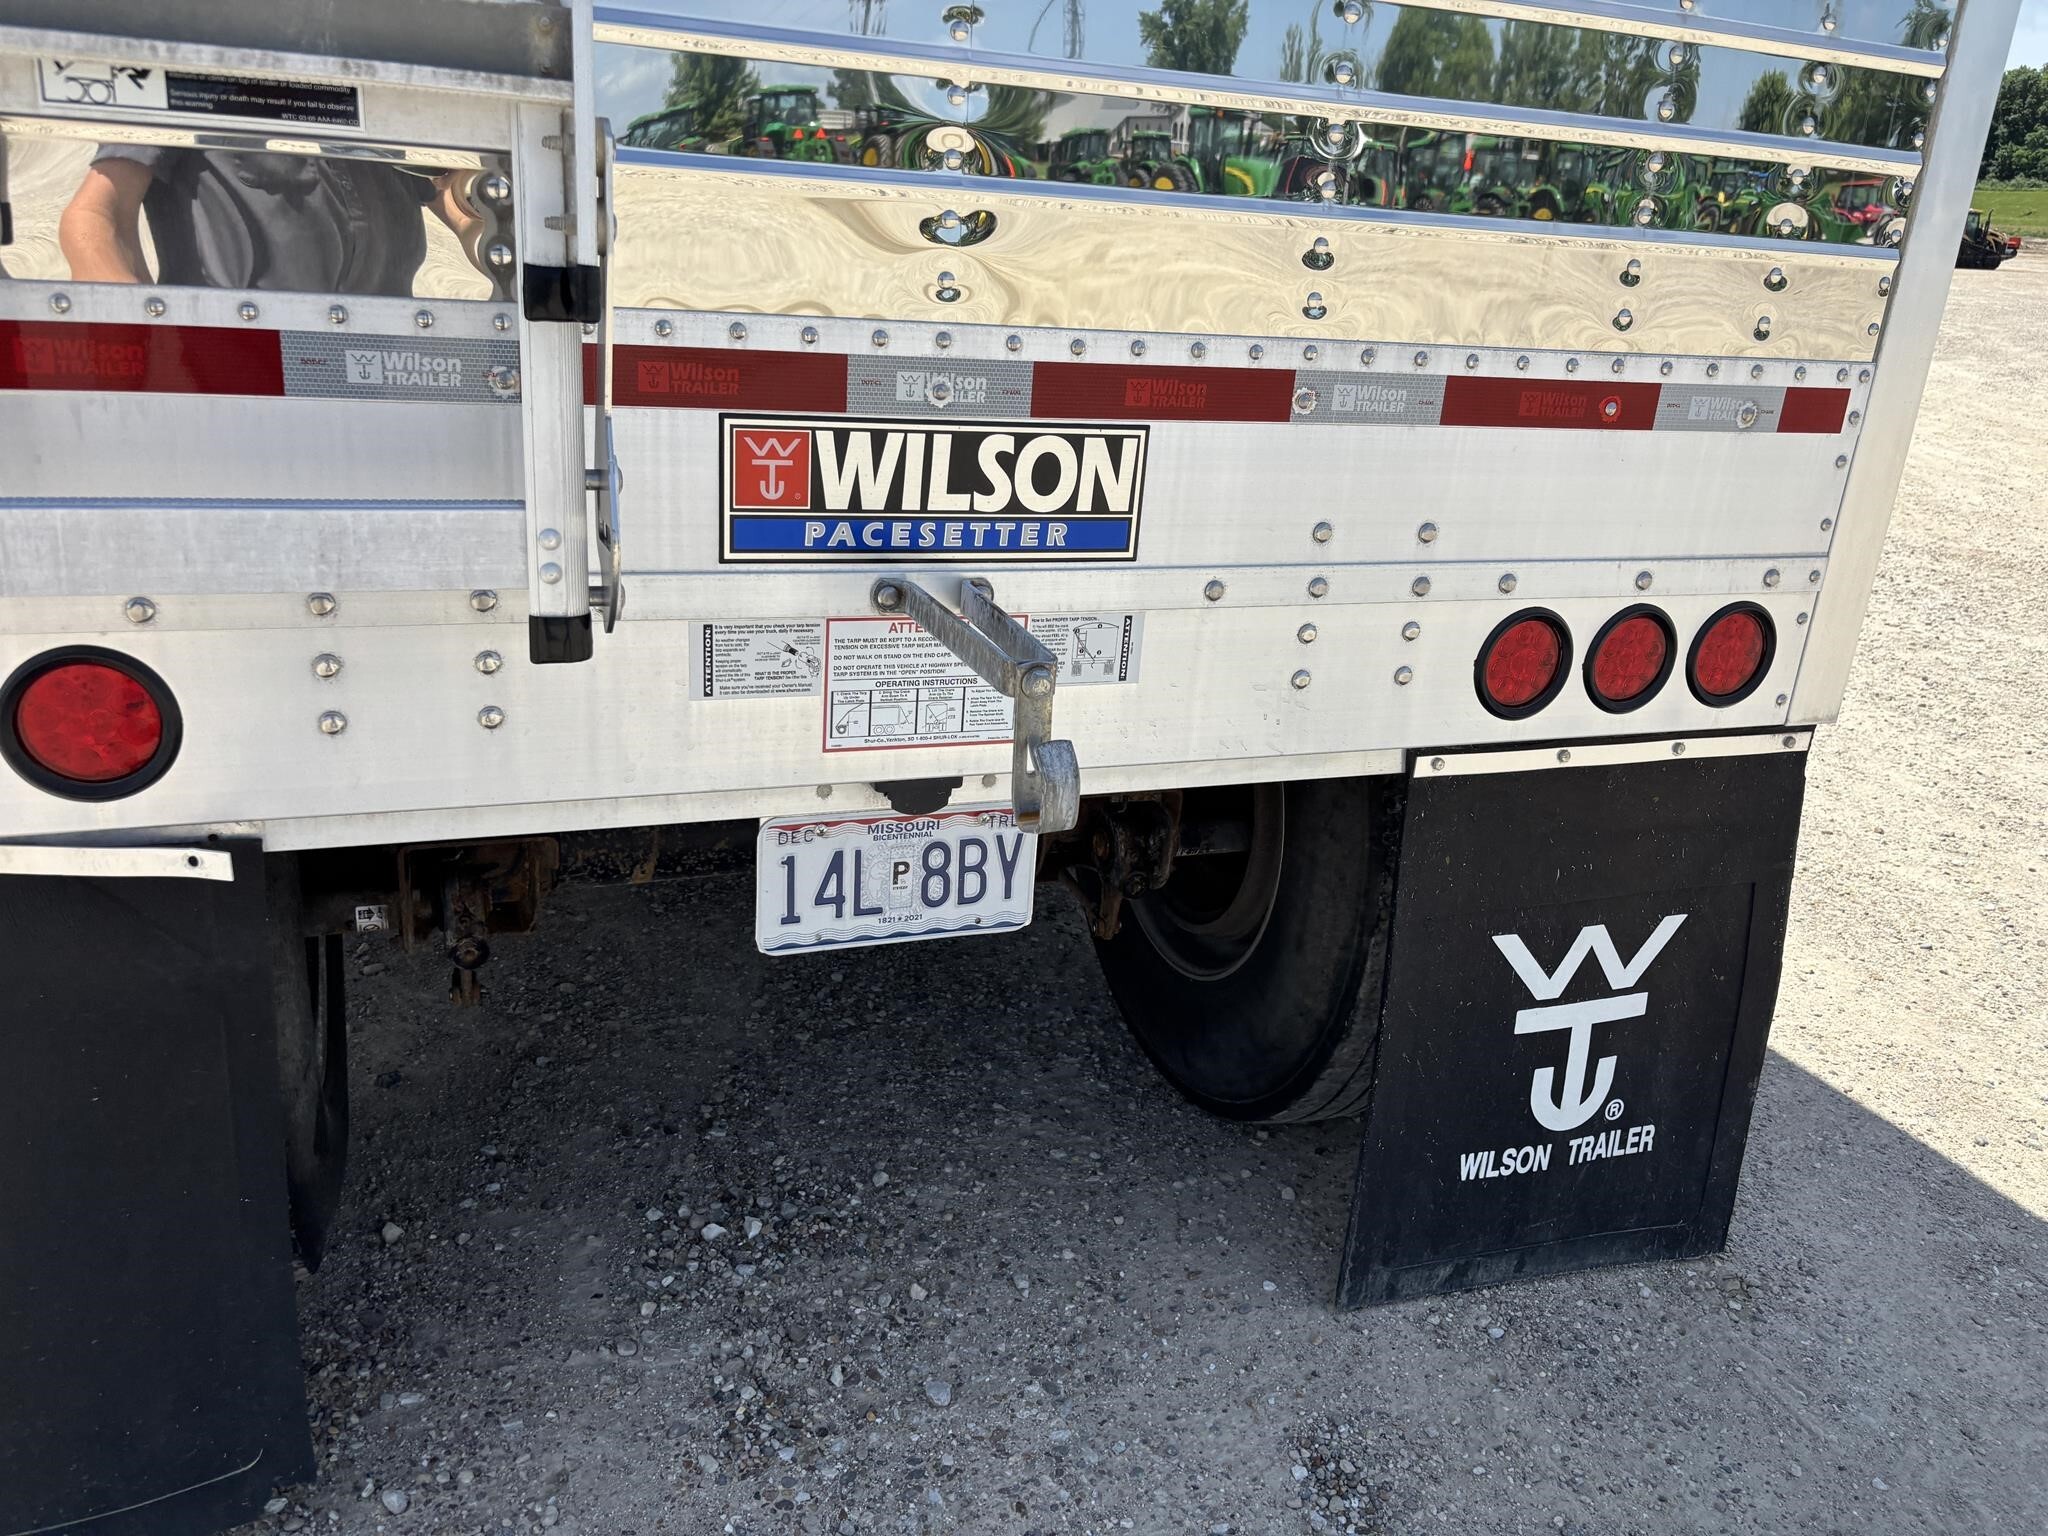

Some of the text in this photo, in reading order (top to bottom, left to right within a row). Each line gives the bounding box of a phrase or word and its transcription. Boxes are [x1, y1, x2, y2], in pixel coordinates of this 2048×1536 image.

[170, 89, 198, 98] Serious
[200, 93, 218, 101] injury
[229, 94, 249, 102] death
[289, 82, 312, 90] loaded
[314, 85, 351, 94] commodity
[54, 338, 145, 360] Wilson
[57, 360, 145, 376] TRAILER
[382, 351, 462, 372] Wilson
[384, 372, 462, 387] TRAILER
[670, 362, 740, 382] Wilson
[672, 380, 740, 396] TRAILER
[1152, 378, 1208, 395] Wilson
[1357, 385, 1407, 400] Wilson
[1152, 395, 1206, 408] TRAILER
[1355, 400, 1405, 413] TRAILER
[1542, 392, 1588, 406] Wilson
[1541, 406, 1584, 418] TRAILER
[815, 430, 1138, 514] WILSON
[804, 521, 1069, 548] PACESETTER
[1119, 618, 1132, 679] ATTENTION:
[704, 626, 712, 695] ATTENTION:
[876, 678, 978, 688] OPERATING INSTRUCTIONS
[867, 820, 941, 835] MISSOURI
[778, 830, 815, 846] DEC
[872, 830, 934, 842] BICENTENNIAL
[780, 832, 1024, 925] 14L 8BY
[892, 861, 910, 886] P
[878, 913, 923, 924] 1821 2021
[1460, 1124, 1656, 1182] WILSON TRAILER
